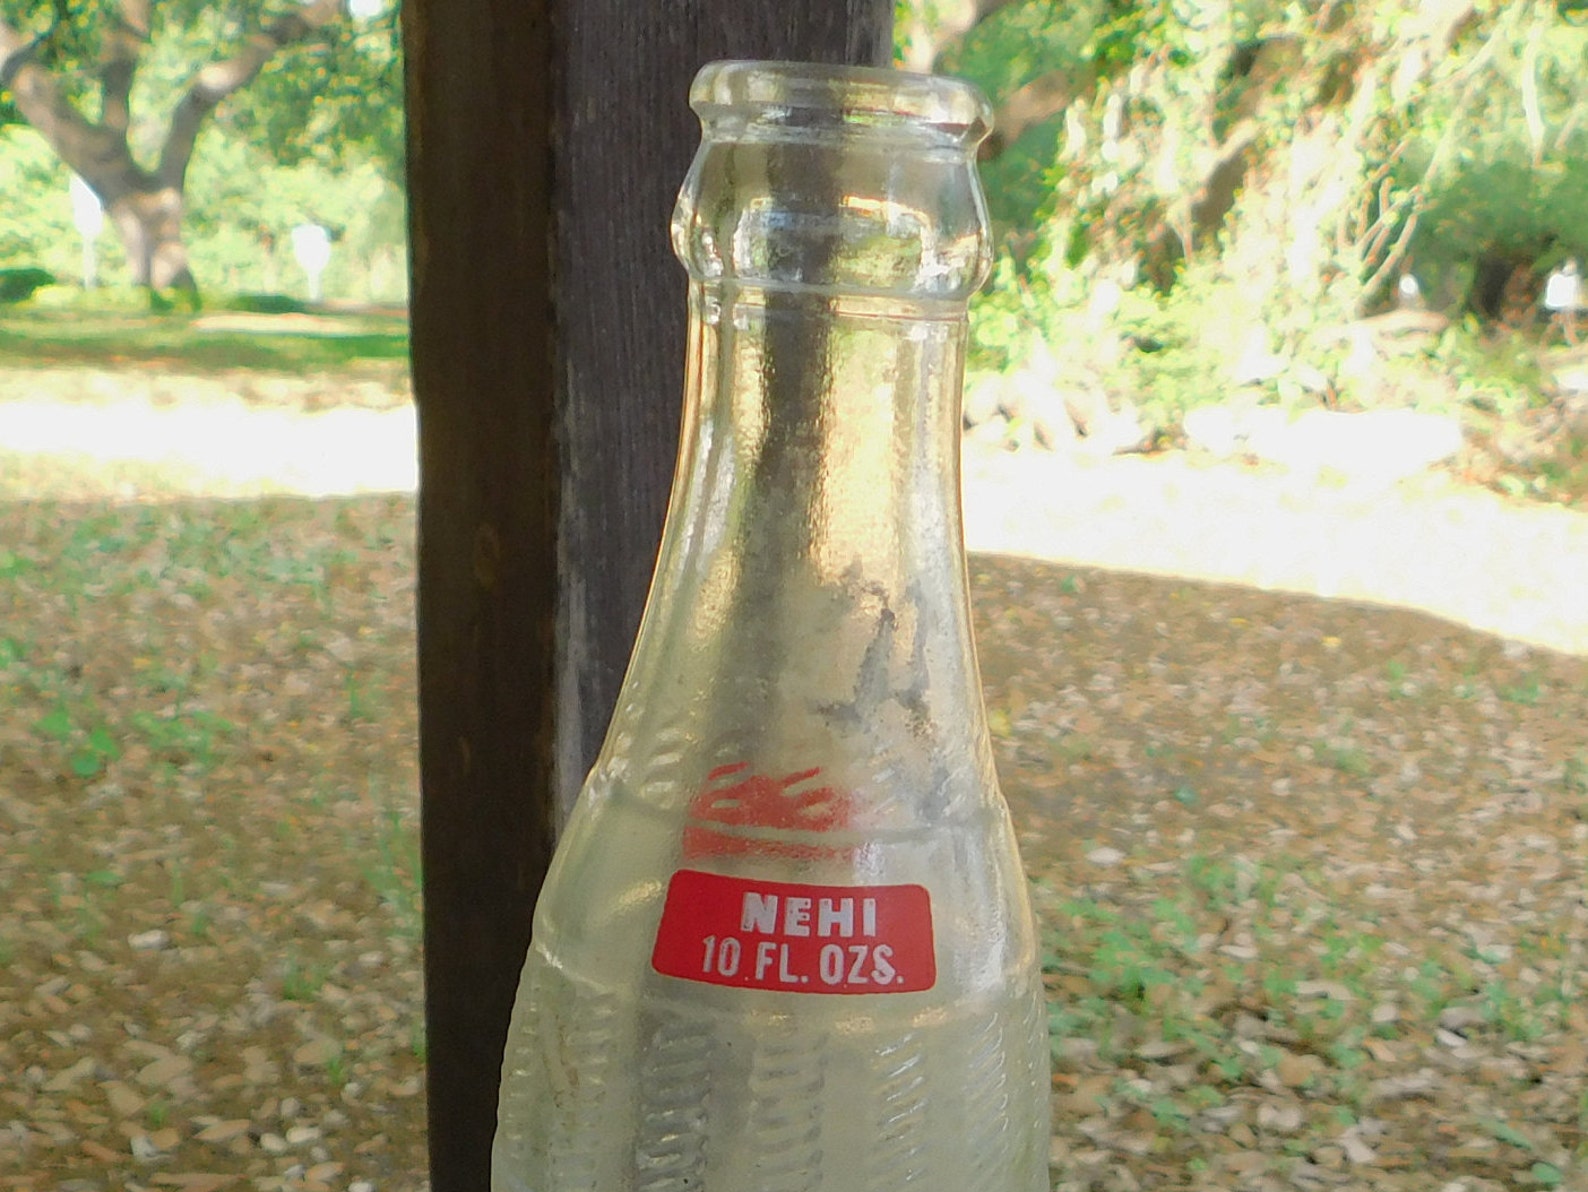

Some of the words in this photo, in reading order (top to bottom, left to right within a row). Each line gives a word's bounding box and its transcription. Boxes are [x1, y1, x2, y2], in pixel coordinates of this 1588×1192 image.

[741, 893, 877, 937] NEHI
[702, 935, 741, 977] 10
[755, 941, 808, 983] FL.
[819, 944, 904, 985] OZS.
